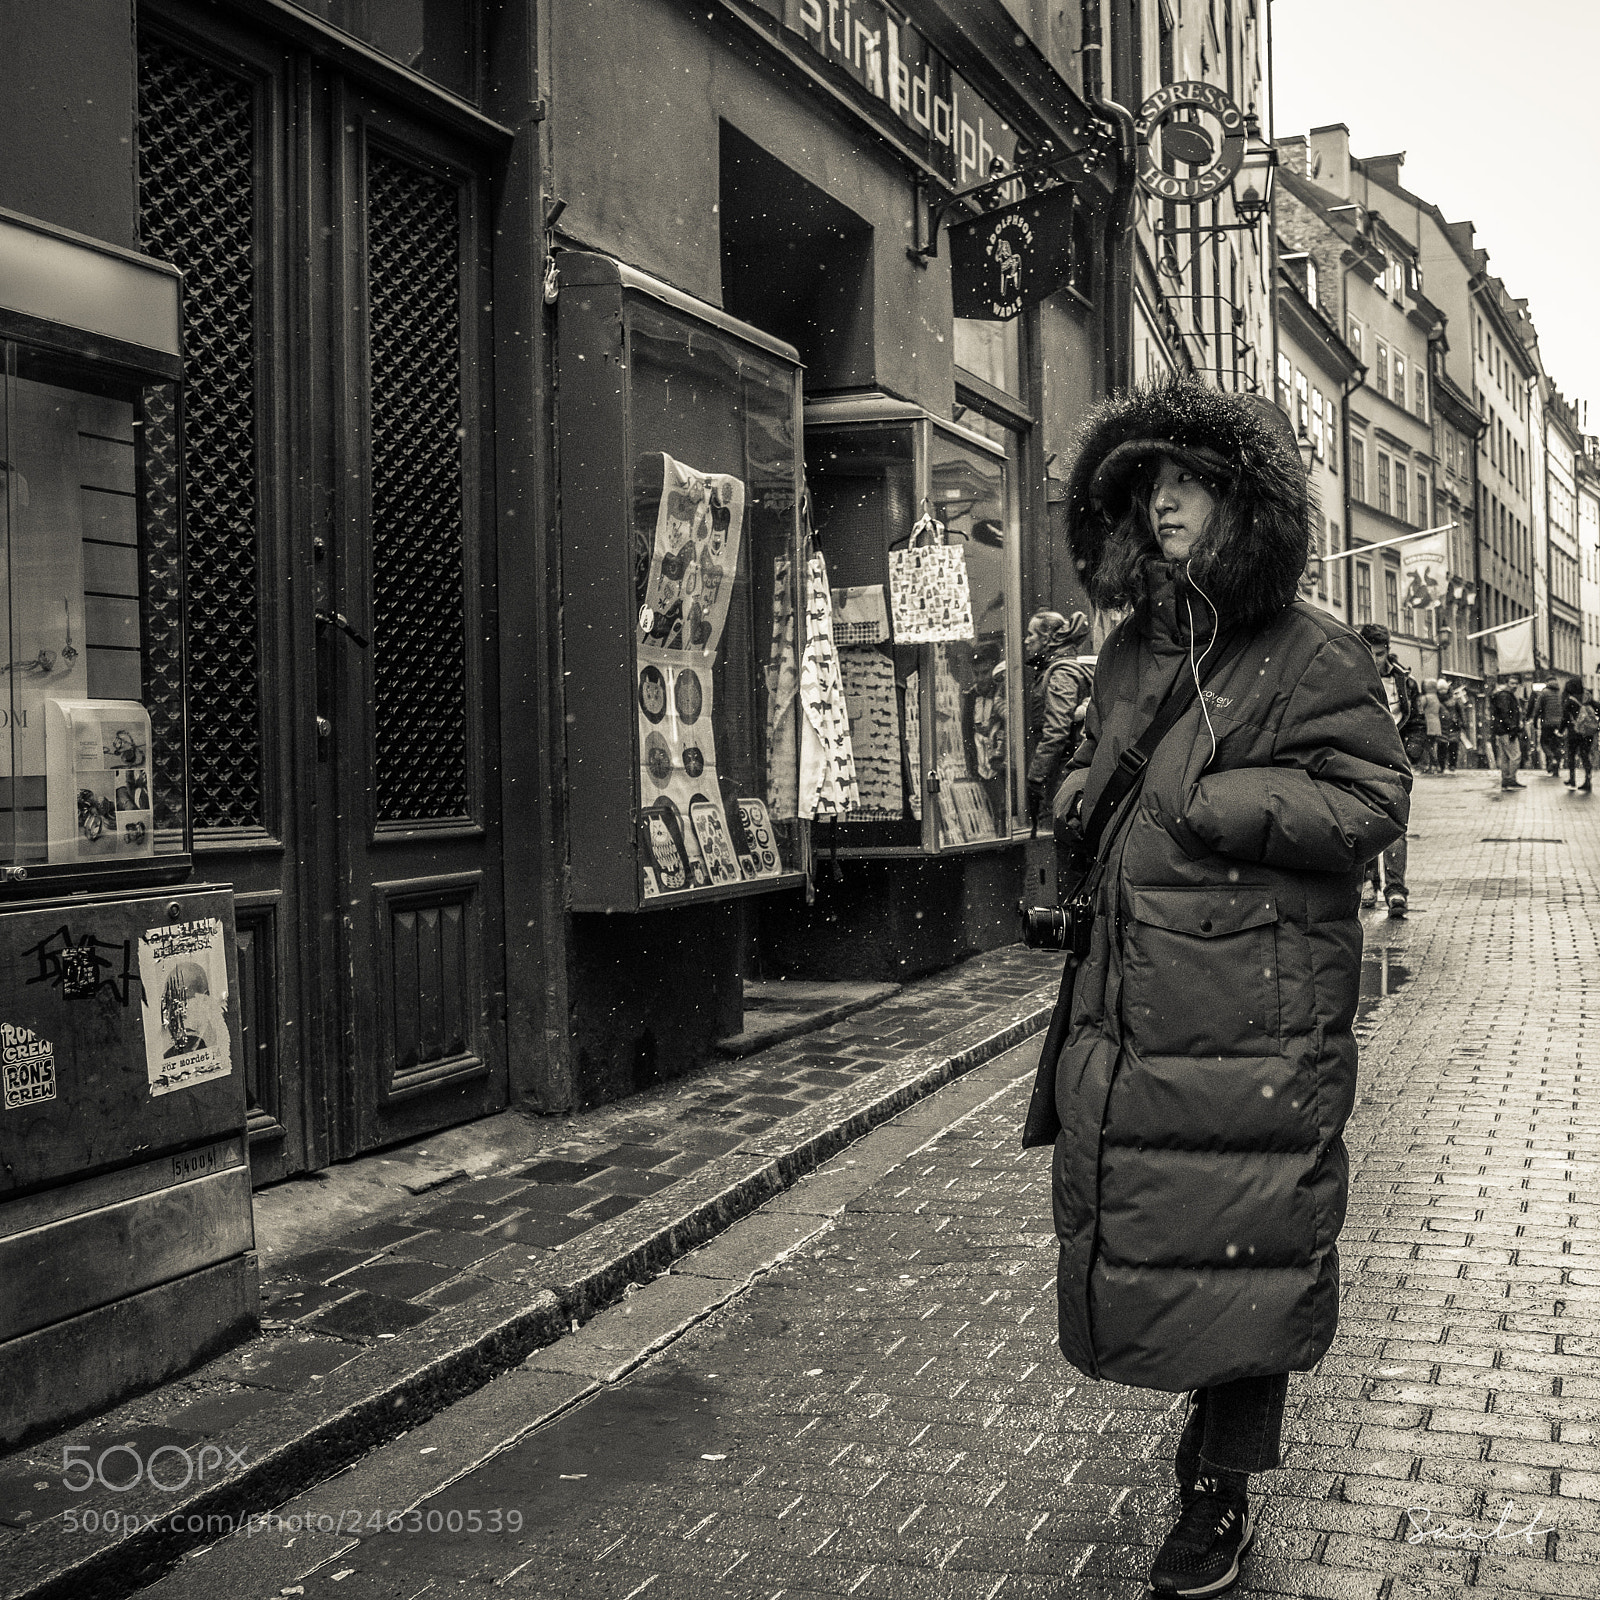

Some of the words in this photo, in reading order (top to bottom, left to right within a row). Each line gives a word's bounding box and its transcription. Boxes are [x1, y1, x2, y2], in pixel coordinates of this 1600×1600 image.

[1133, 83, 1240, 137] ESPRESSO
[1140, 163, 1231, 197] HOUSE
[985, 214, 1034, 256] ADOLPHSON
[5, 1039, 52, 1061] CREW
[7, 1060, 53, 1090] RON'S
[8, 1082, 54, 1103] CREW
[175, 1152, 213, 1176] 54004
